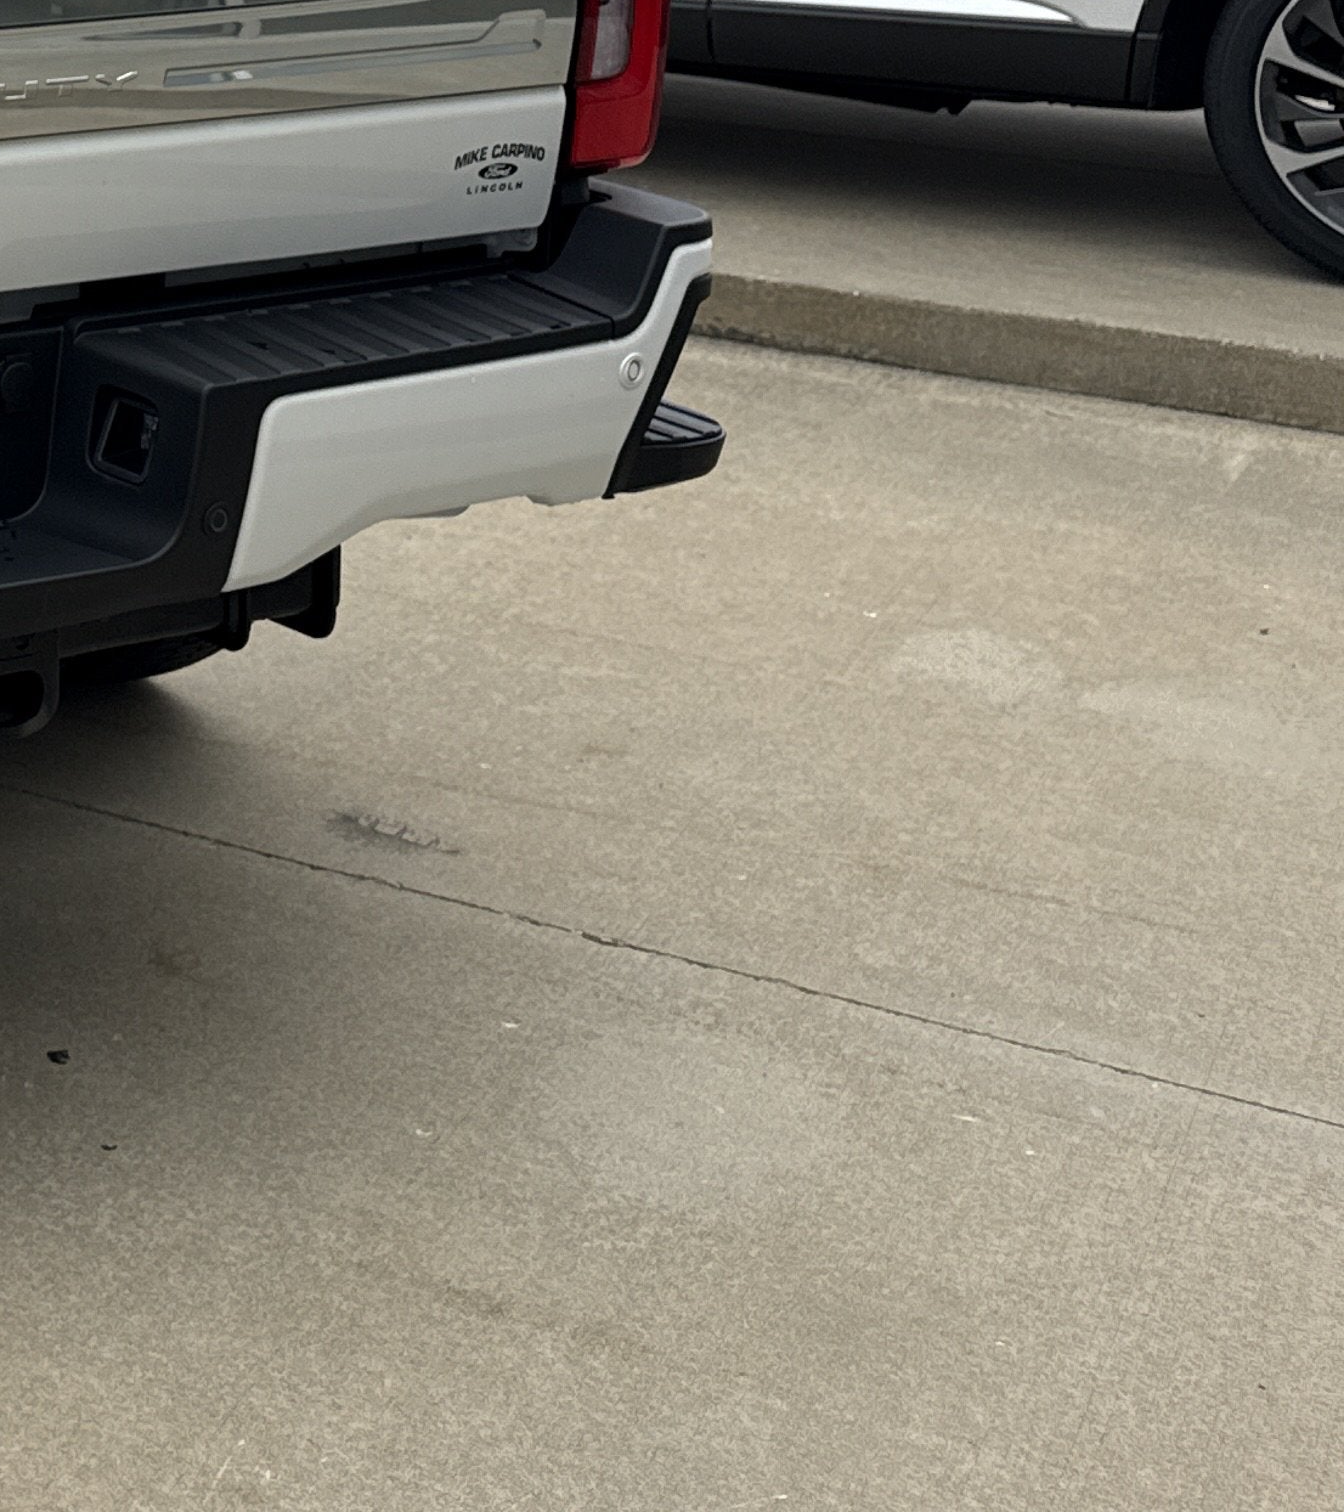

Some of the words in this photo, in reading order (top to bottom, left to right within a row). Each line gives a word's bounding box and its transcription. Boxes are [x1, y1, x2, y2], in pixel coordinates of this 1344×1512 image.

[454, 146, 489, 170] MIKE
[492, 143, 545, 162] CARPINO
[466, 181, 523, 195] LINCOLN
